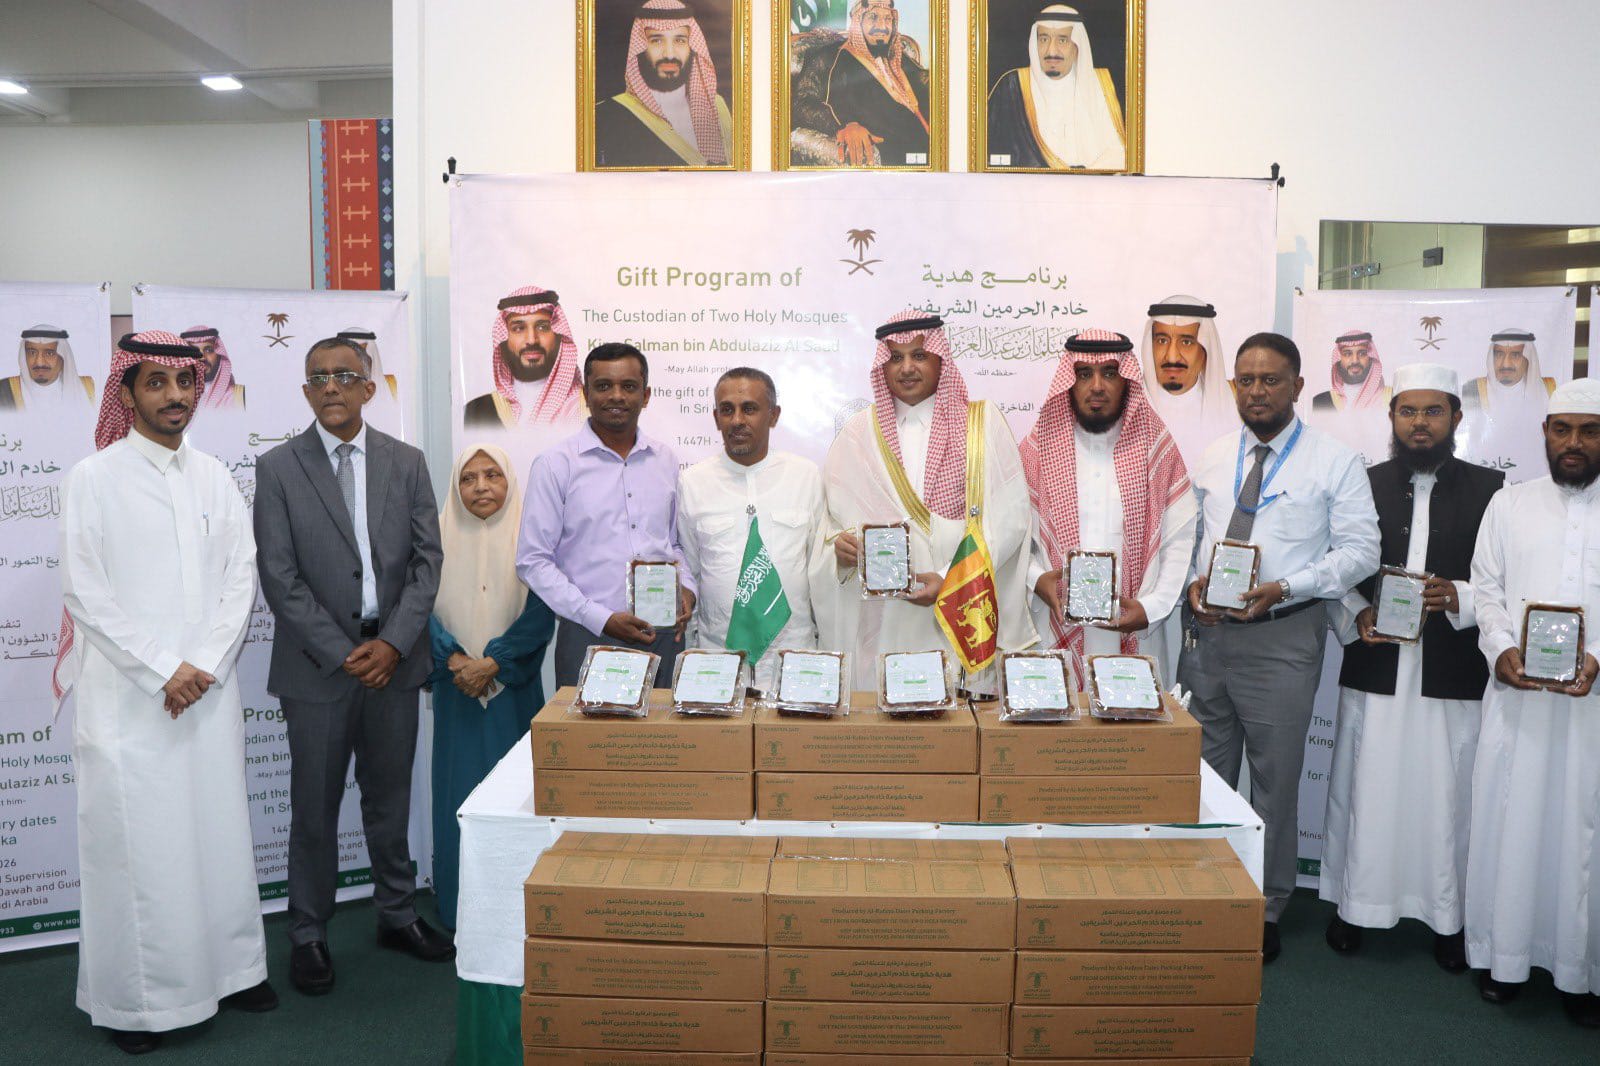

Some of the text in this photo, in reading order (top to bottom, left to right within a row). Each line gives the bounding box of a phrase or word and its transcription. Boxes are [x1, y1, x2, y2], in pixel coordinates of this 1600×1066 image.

[617, 266, 802, 291] Gift Program of
[922, 264, 974, 288] هدية
[983, 300, 1045, 319] الحرمين
[1051, 301, 1088, 319] خادم
[582, 309, 848, 326] The Custodian of Two Holy Mosques
[683, 339, 705, 351] bin
[709, 339, 781, 352] Abdulaziz
[786, 339, 799, 351] Al
[804, 339, 840, 352] Saud
[687, 366, 709, 374] Allah
[654, 387, 709, 399] the gift of
[681, 404, 709, 414] In Sri
[677, 437, 711, 446] 1447H
[21, 459, 61, 478] خادم
[1313, 716, 1332, 727] The
[33, 725, 52, 742] of
[1308, 736, 1334, 748] King
[1, 756, 30, 768] Holy
[272, 752, 290, 762] bin
[44, 774, 58, 786] Al
[1307, 771, 1323, 781] for
[271, 789, 289, 799] the
[264, 804, 275, 815] In
[20, 816, 57, 828] dates
[347, 841, 362, 850] and
[5, 870, 67, 883] Supervision
[36, 882, 54, 892] and
[15, 897, 48, 907] Arabia
